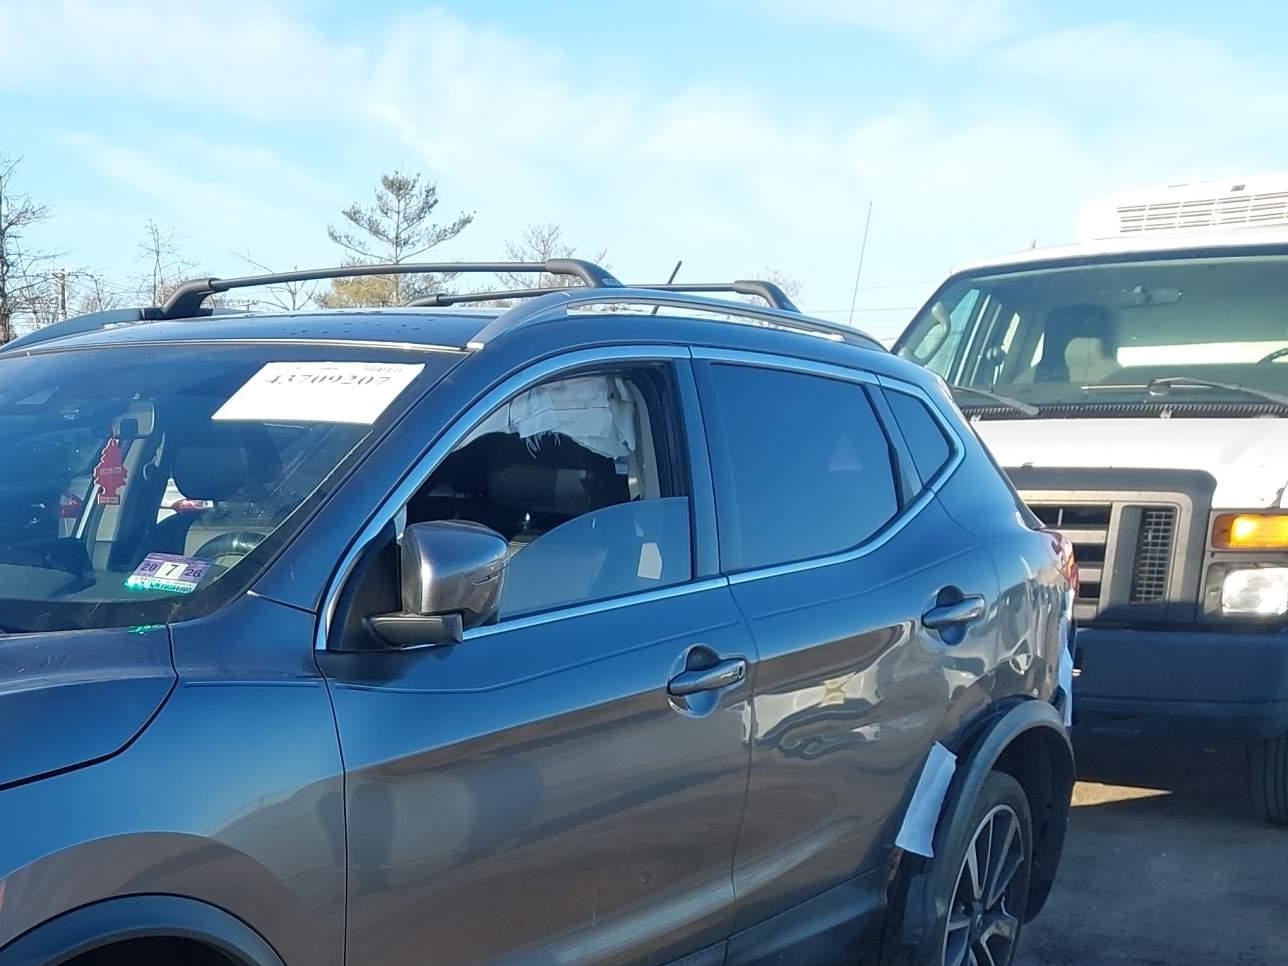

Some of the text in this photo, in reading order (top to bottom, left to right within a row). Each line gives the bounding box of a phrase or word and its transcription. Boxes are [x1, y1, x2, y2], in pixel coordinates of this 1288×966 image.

[266, 374, 393, 385] 43709207
[141, 562, 202, 577] 20 7 26
